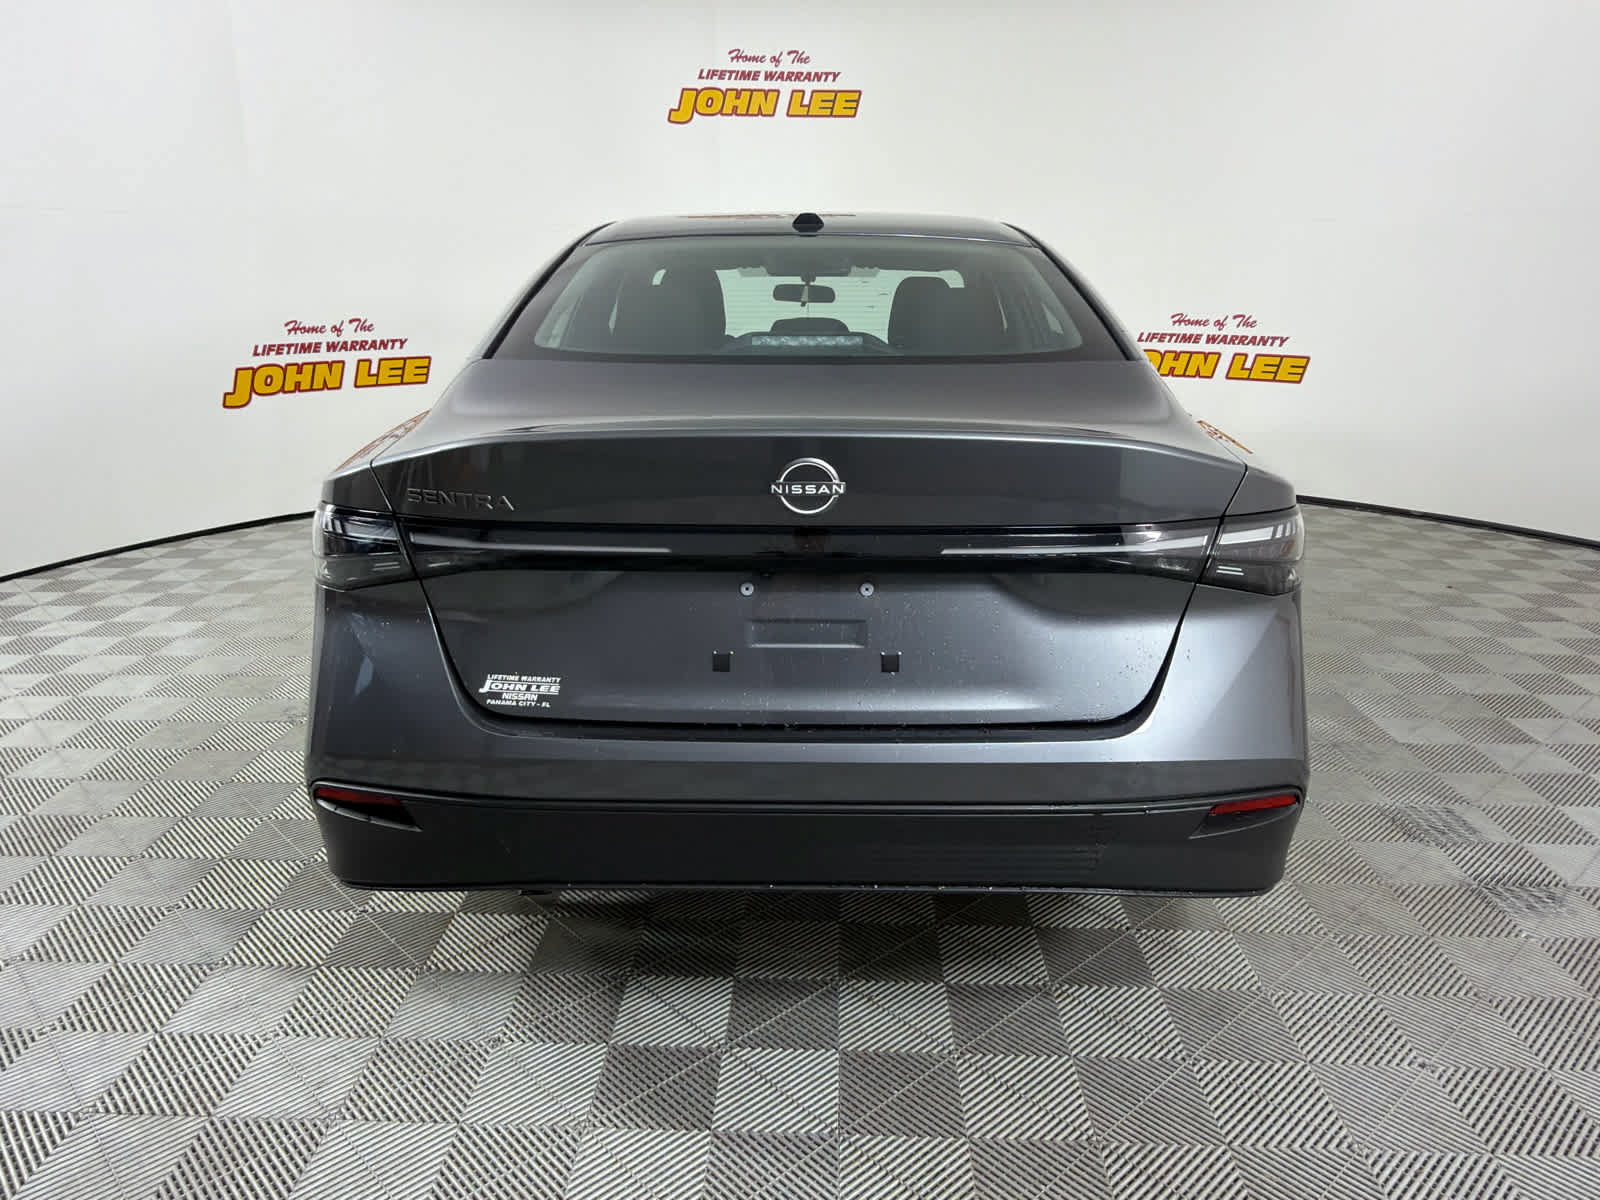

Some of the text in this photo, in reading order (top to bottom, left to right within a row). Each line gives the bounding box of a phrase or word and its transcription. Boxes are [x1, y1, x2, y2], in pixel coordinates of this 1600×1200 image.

[728, 48, 811, 67] Home of The
[698, 69, 841, 82] LIFETIME WARRANTY
[668, 87, 862, 124] JOHN LEE
[284, 318, 375, 337] Home of The
[1170, 312, 1257, 331] Home of The
[252, 338, 408, 357] LIFETIME WARRANTY
[1137, 332, 1289, 347] LIFETIME WARRANTY
[1225, 353, 1311, 384] LEE
[222, 355, 432, 409] JOHN LEE
[770, 484, 845, 495] NISSAN
[407, 488, 515, 511] SENTRA
[478, 680, 561, 693] JOHN LEE
[521, 675, 562, 683] WARRANTY
[501, 693, 538, 701] NISSAN
